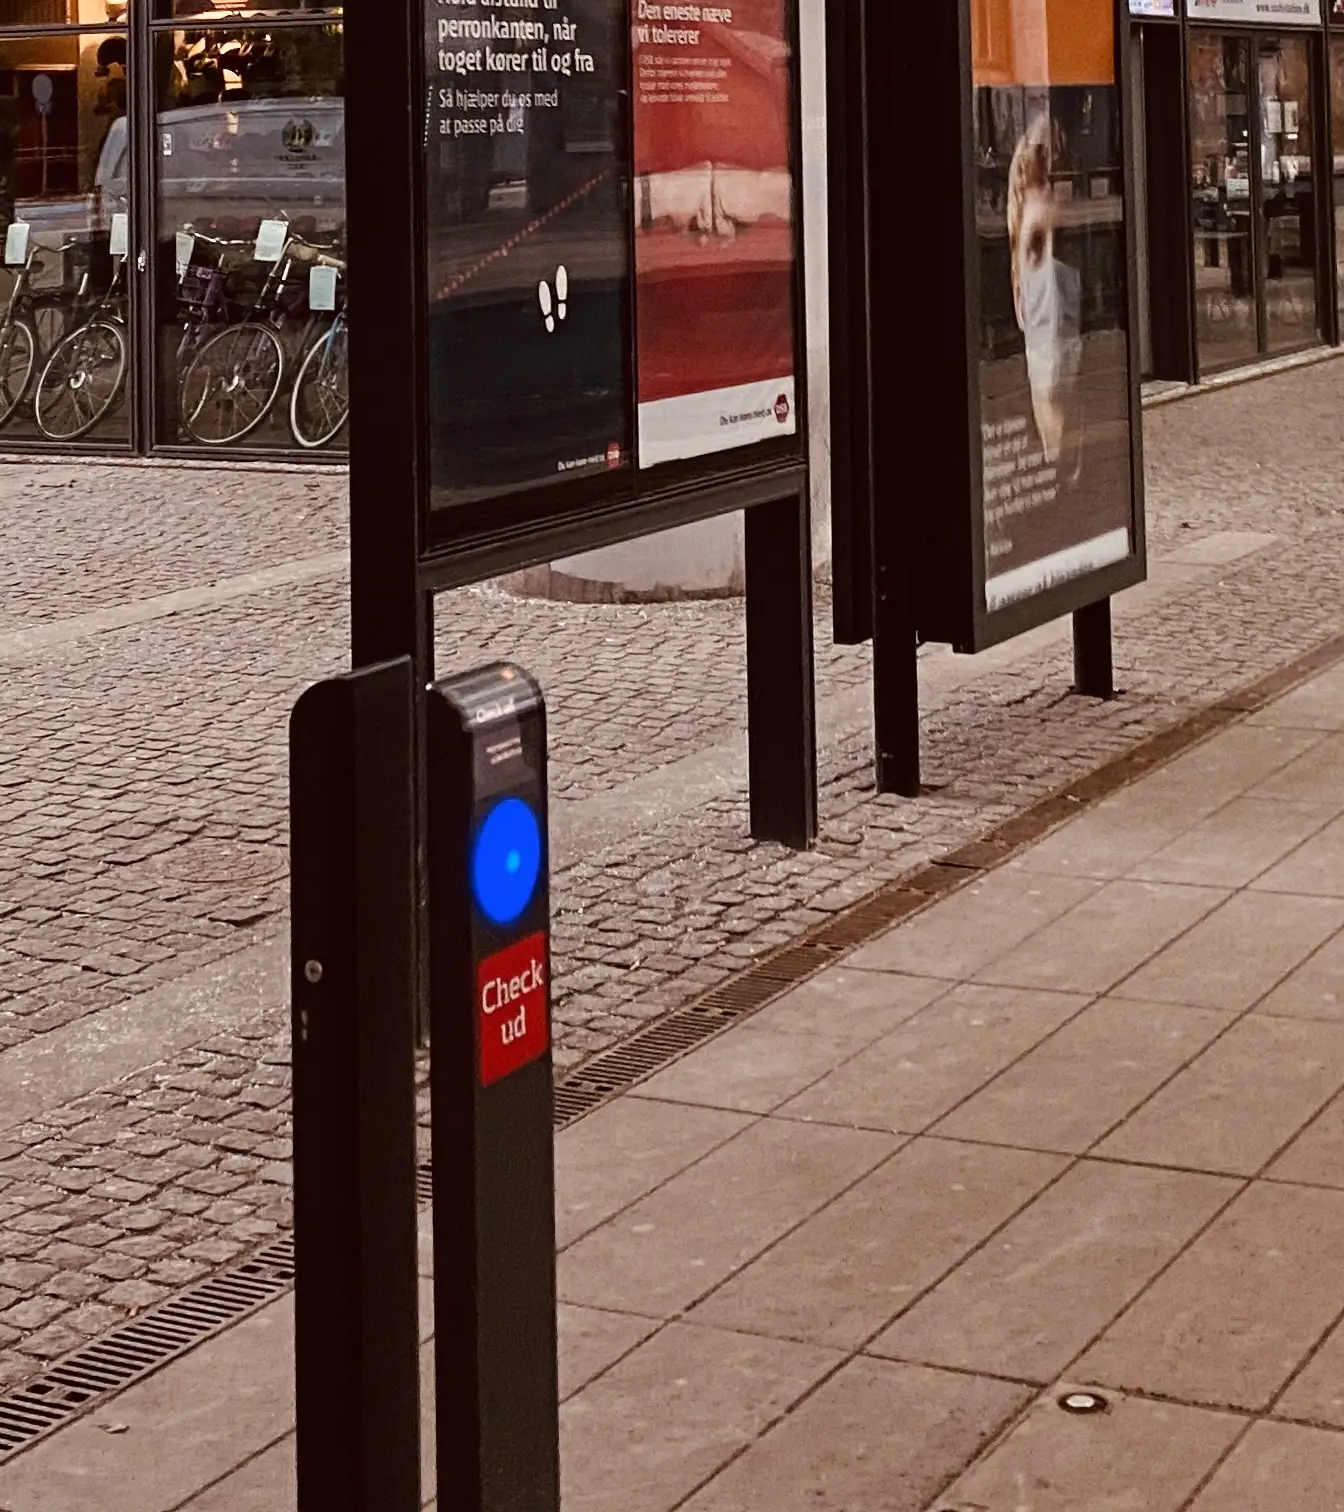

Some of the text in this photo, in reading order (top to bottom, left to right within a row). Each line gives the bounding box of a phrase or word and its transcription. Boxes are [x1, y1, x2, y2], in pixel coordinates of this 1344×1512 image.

[638, 0, 661, 20] Den
[663, 5, 700, 22] eneste
[437, 14, 577, 43] perronkanten, når
[637, 24, 700, 45] vi tolererer
[438, 46, 594, 76] toget kører til og fra
[439, 88, 558, 111] Så hjælper du os med
[439, 113, 524, 137] at passe på dig
[481, 959, 544, 1015] Check
[500, 1006, 527, 1045] ud
